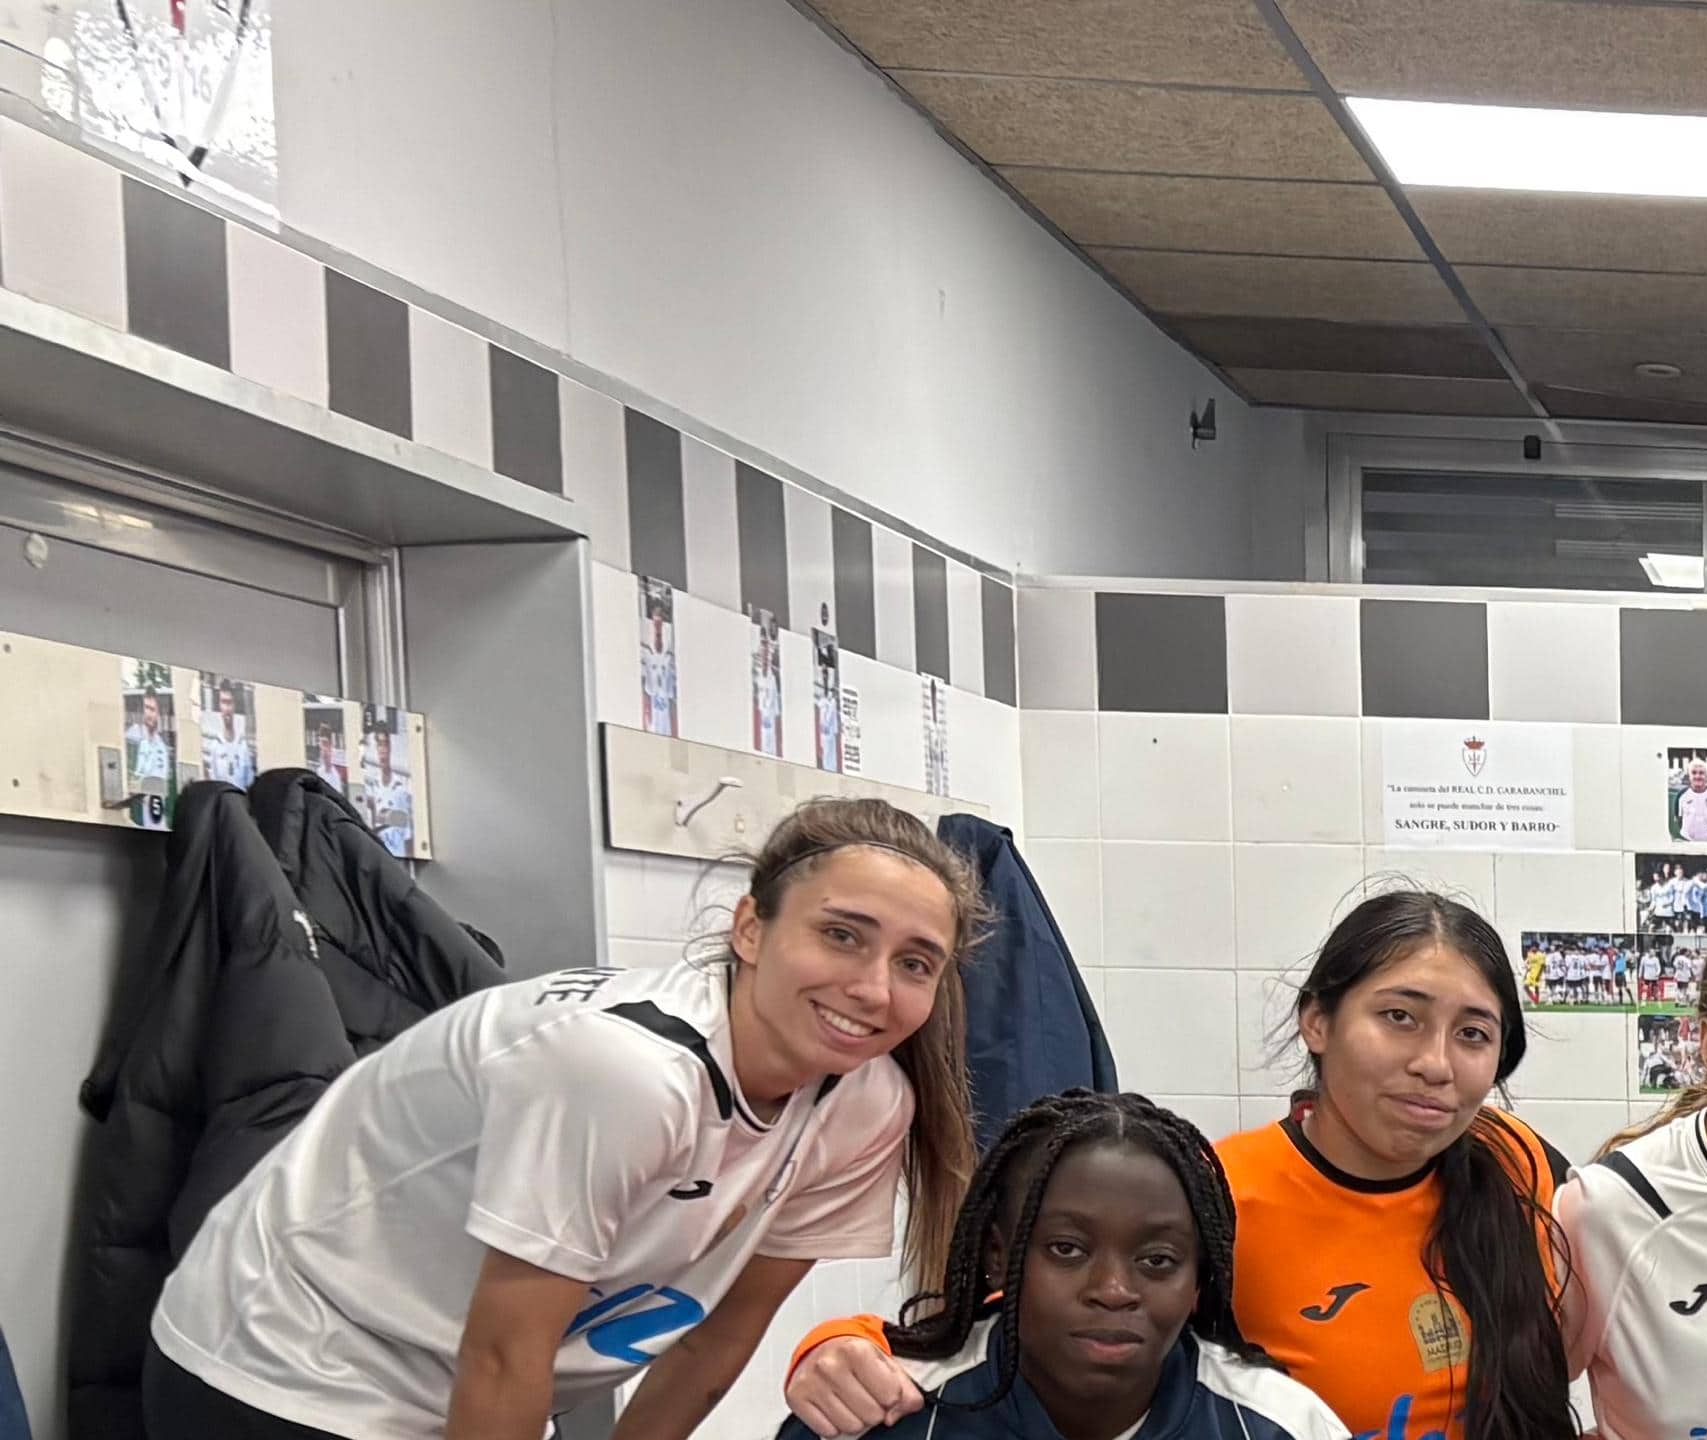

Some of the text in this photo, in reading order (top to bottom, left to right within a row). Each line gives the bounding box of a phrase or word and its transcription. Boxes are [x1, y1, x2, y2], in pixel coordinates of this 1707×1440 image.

[1438, 785, 1450, 793] del
[1451, 785, 1476, 794] REAL
[1497, 786, 1567, 796] CARABANCHEL
[1395, 819, 1450, 832] SANGRE,
[1453, 820, 1497, 831] SUDOR
[1500, 821, 1510, 831] Y
